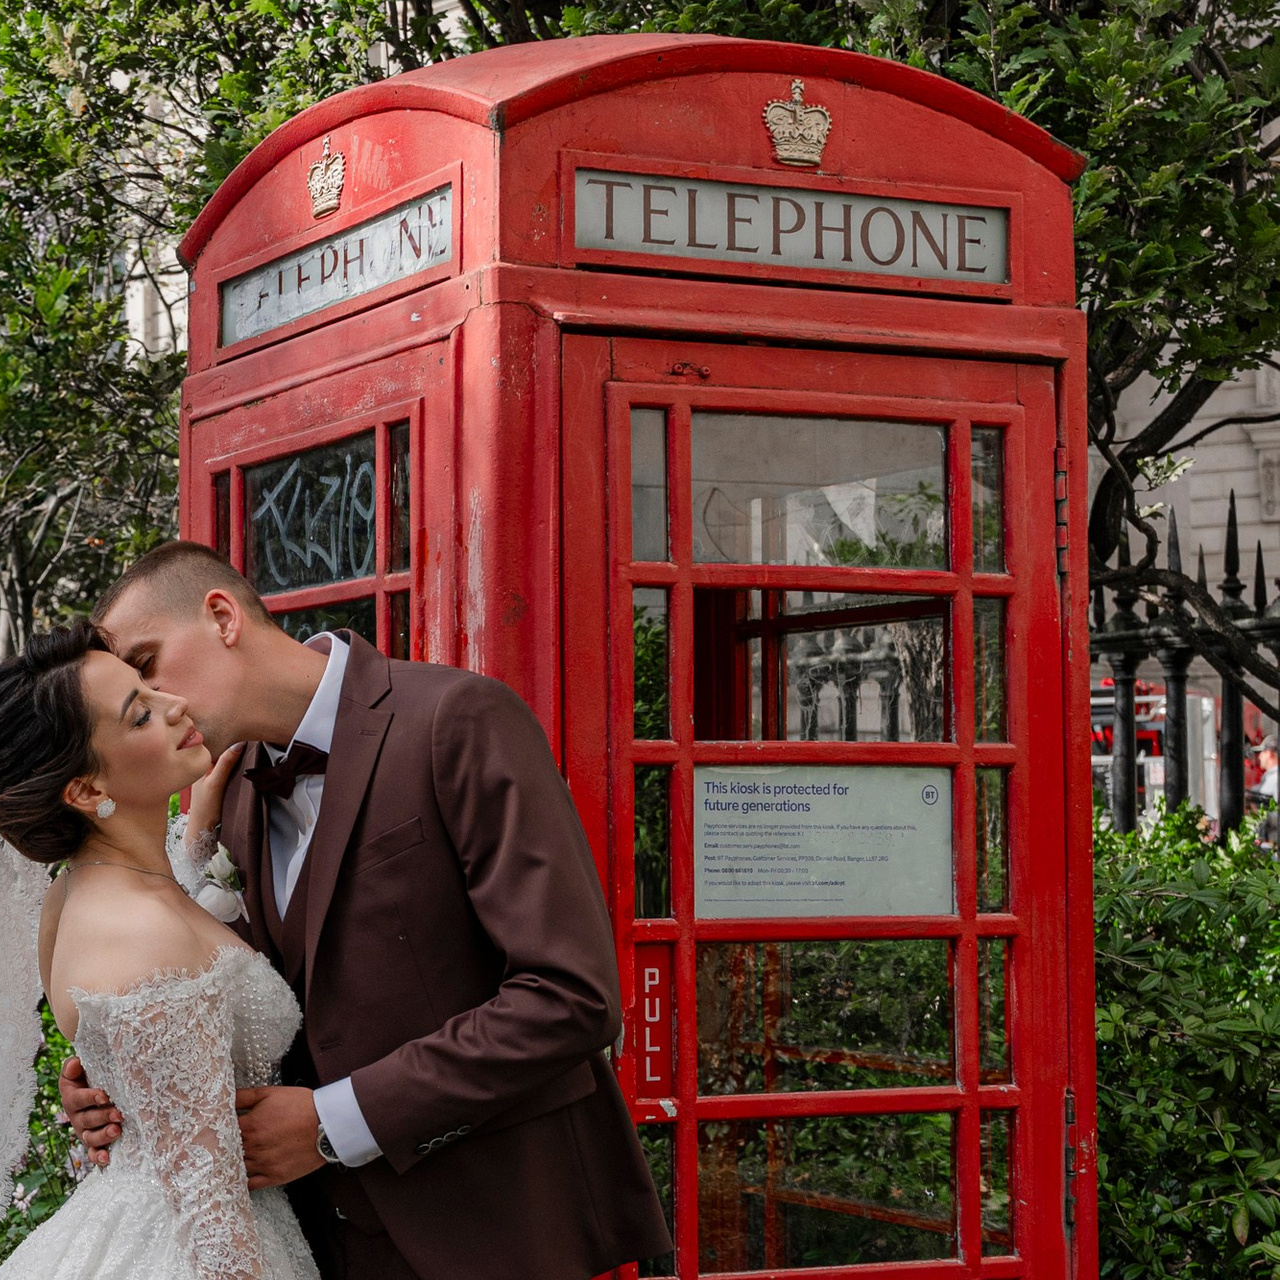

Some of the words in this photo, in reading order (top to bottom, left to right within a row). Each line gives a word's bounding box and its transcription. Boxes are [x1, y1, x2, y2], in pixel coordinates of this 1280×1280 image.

[586, 178, 988, 274] TELEPHONE
[704, 781, 728, 794] This
[730, 781, 761, 795] kiosk
[762, 782, 772, 795] is
[773, 782, 831, 798] protected
[832, 783, 849, 796] for
[924, 790, 936, 800] BT
[704, 798, 739, 812] future
[741, 799, 811, 815] generations
[780, 823, 800, 831] provided
[870, 824, 892, 832] questions
[893, 824, 906, 832] about
[644, 967, 662, 1082] PULL
